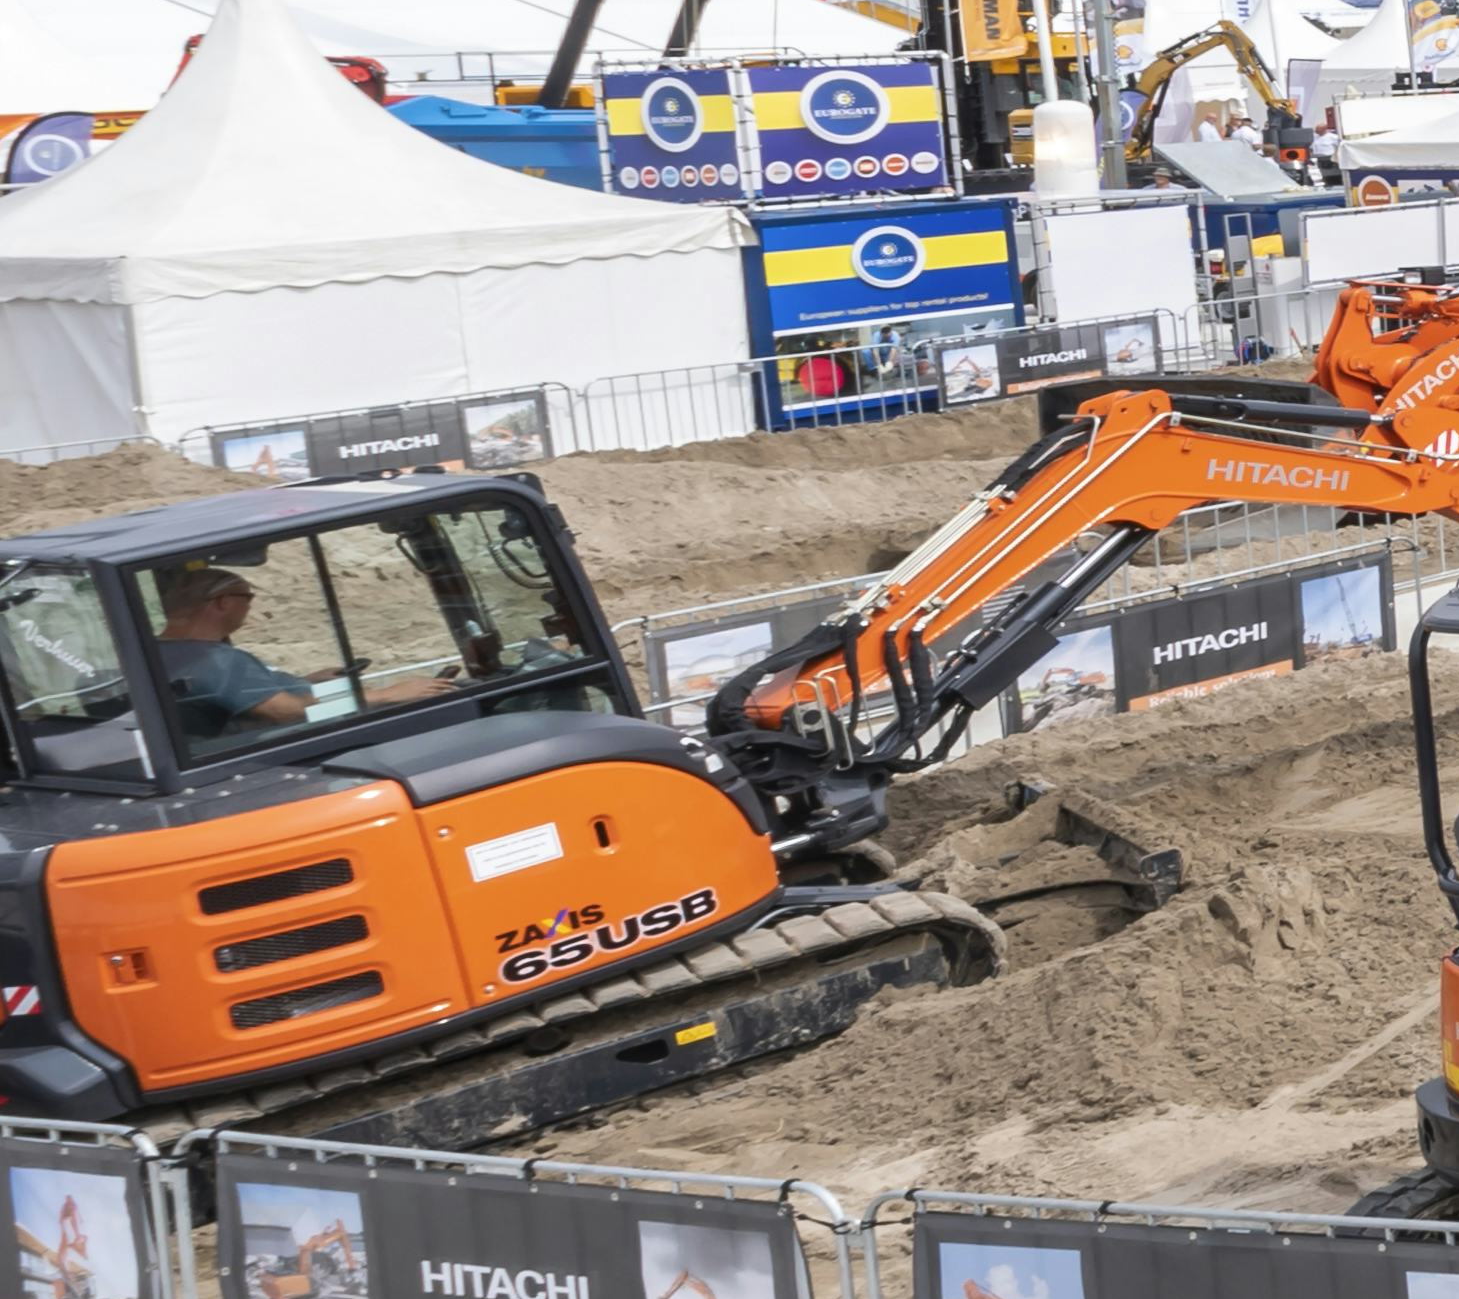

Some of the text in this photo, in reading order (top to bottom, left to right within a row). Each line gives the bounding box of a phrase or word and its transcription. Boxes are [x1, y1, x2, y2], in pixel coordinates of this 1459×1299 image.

[814, 106, 877, 120] EUROGATE
[863, 255, 915, 267] EUROGATE
[1019, 348, 1087, 369] HITACHI
[339, 433, 440, 459] HITACHI
[1207, 458, 1350, 491] HITACHI
[1153, 621, 1268, 665] HITACHI
[495, 903, 606, 954] ZAXIS
[499, 888, 719, 986] 65USB
